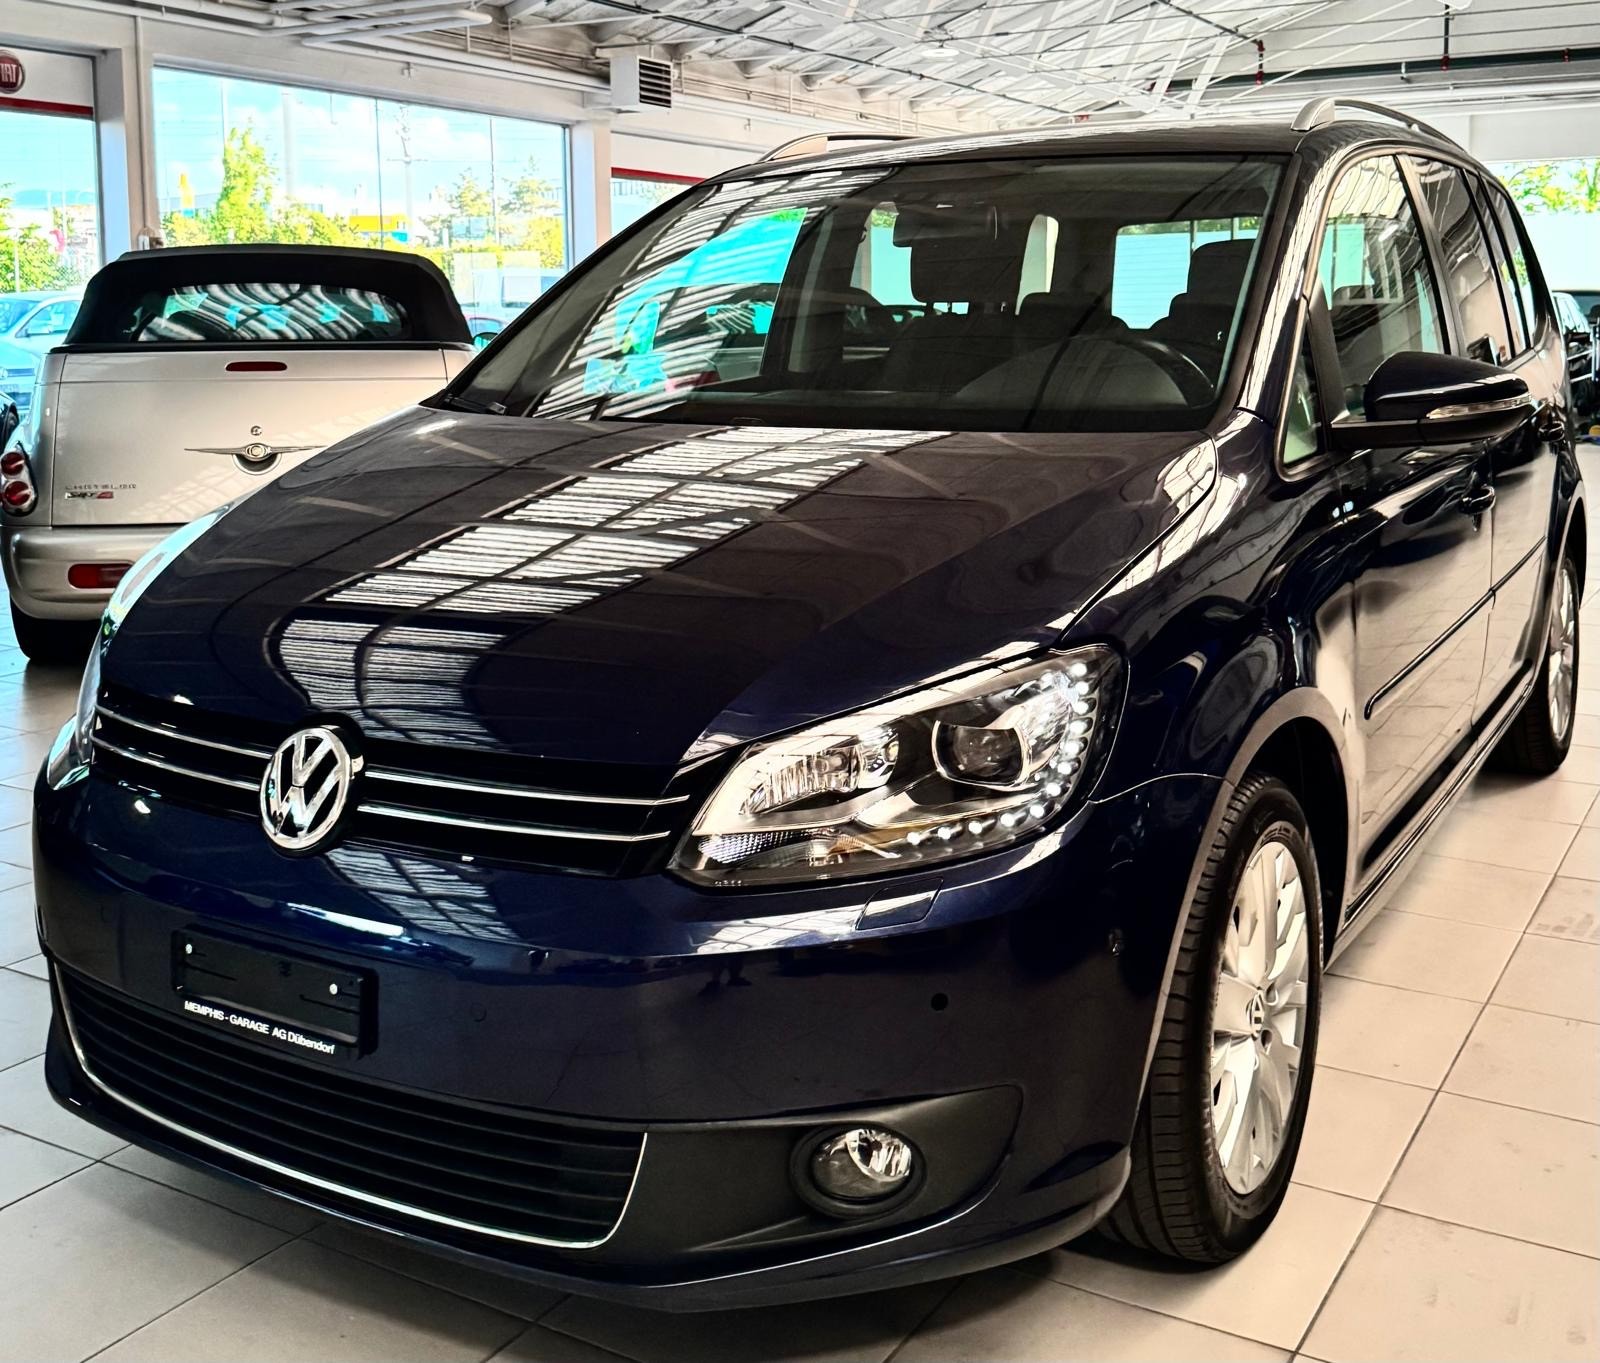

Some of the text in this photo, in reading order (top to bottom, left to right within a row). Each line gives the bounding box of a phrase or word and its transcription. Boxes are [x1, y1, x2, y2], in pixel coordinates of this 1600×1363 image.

[0, 63, 17, 83] IAT
[184, 1000, 224, 1021] MEMPHIS
[229, 1014, 270, 1035] GARAGE
[271, 1026, 287, 1041] AG
[287, 1031, 335, 1055] Dübendorf
